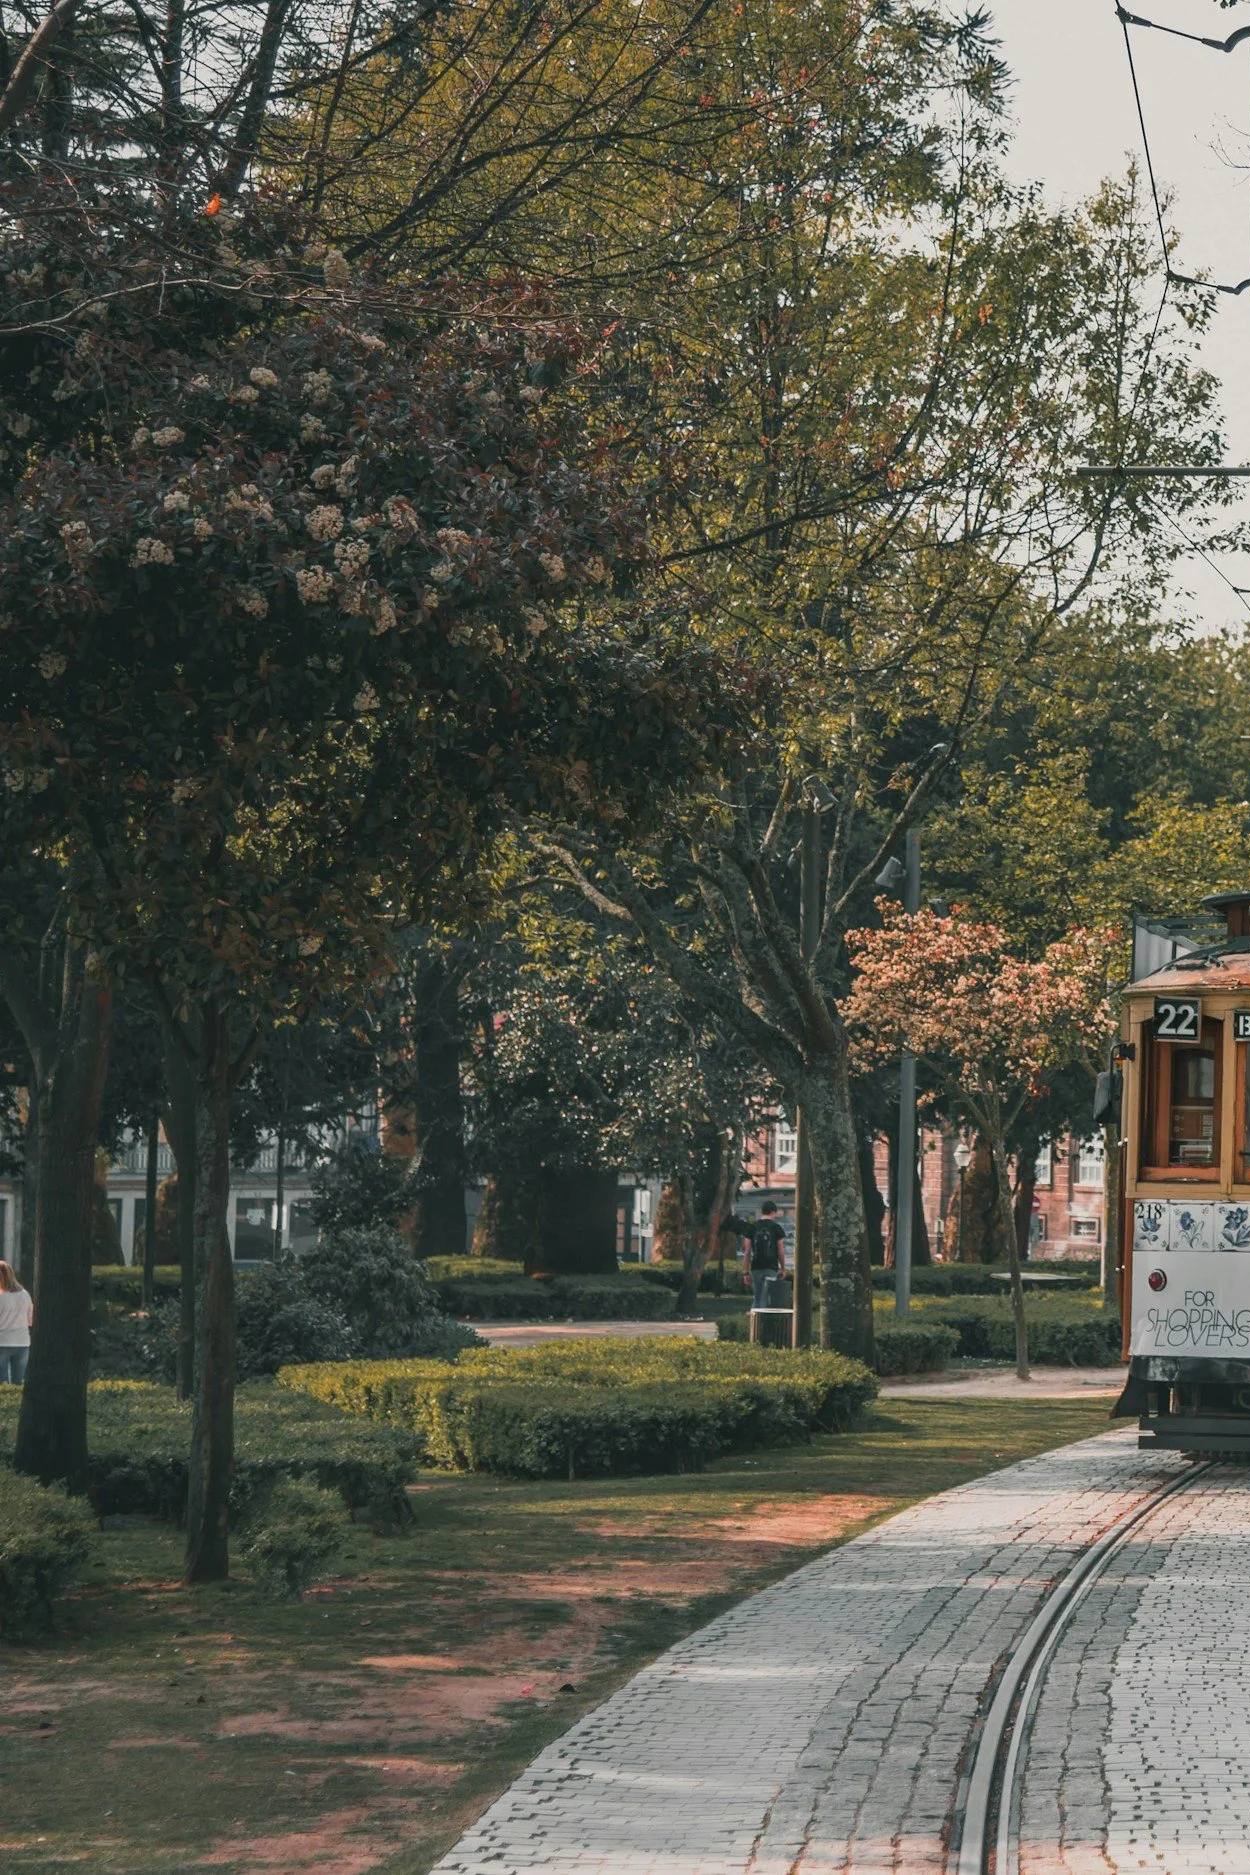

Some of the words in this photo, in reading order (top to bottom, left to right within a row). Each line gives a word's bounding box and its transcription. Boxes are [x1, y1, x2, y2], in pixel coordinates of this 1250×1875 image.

[1157, 1004, 1195, 1035] 22
[1137, 1204, 1162, 1219] 218
[1184, 1291, 1215, 1307] FOR
[1154, 1324, 1250, 1347] LOVERS
